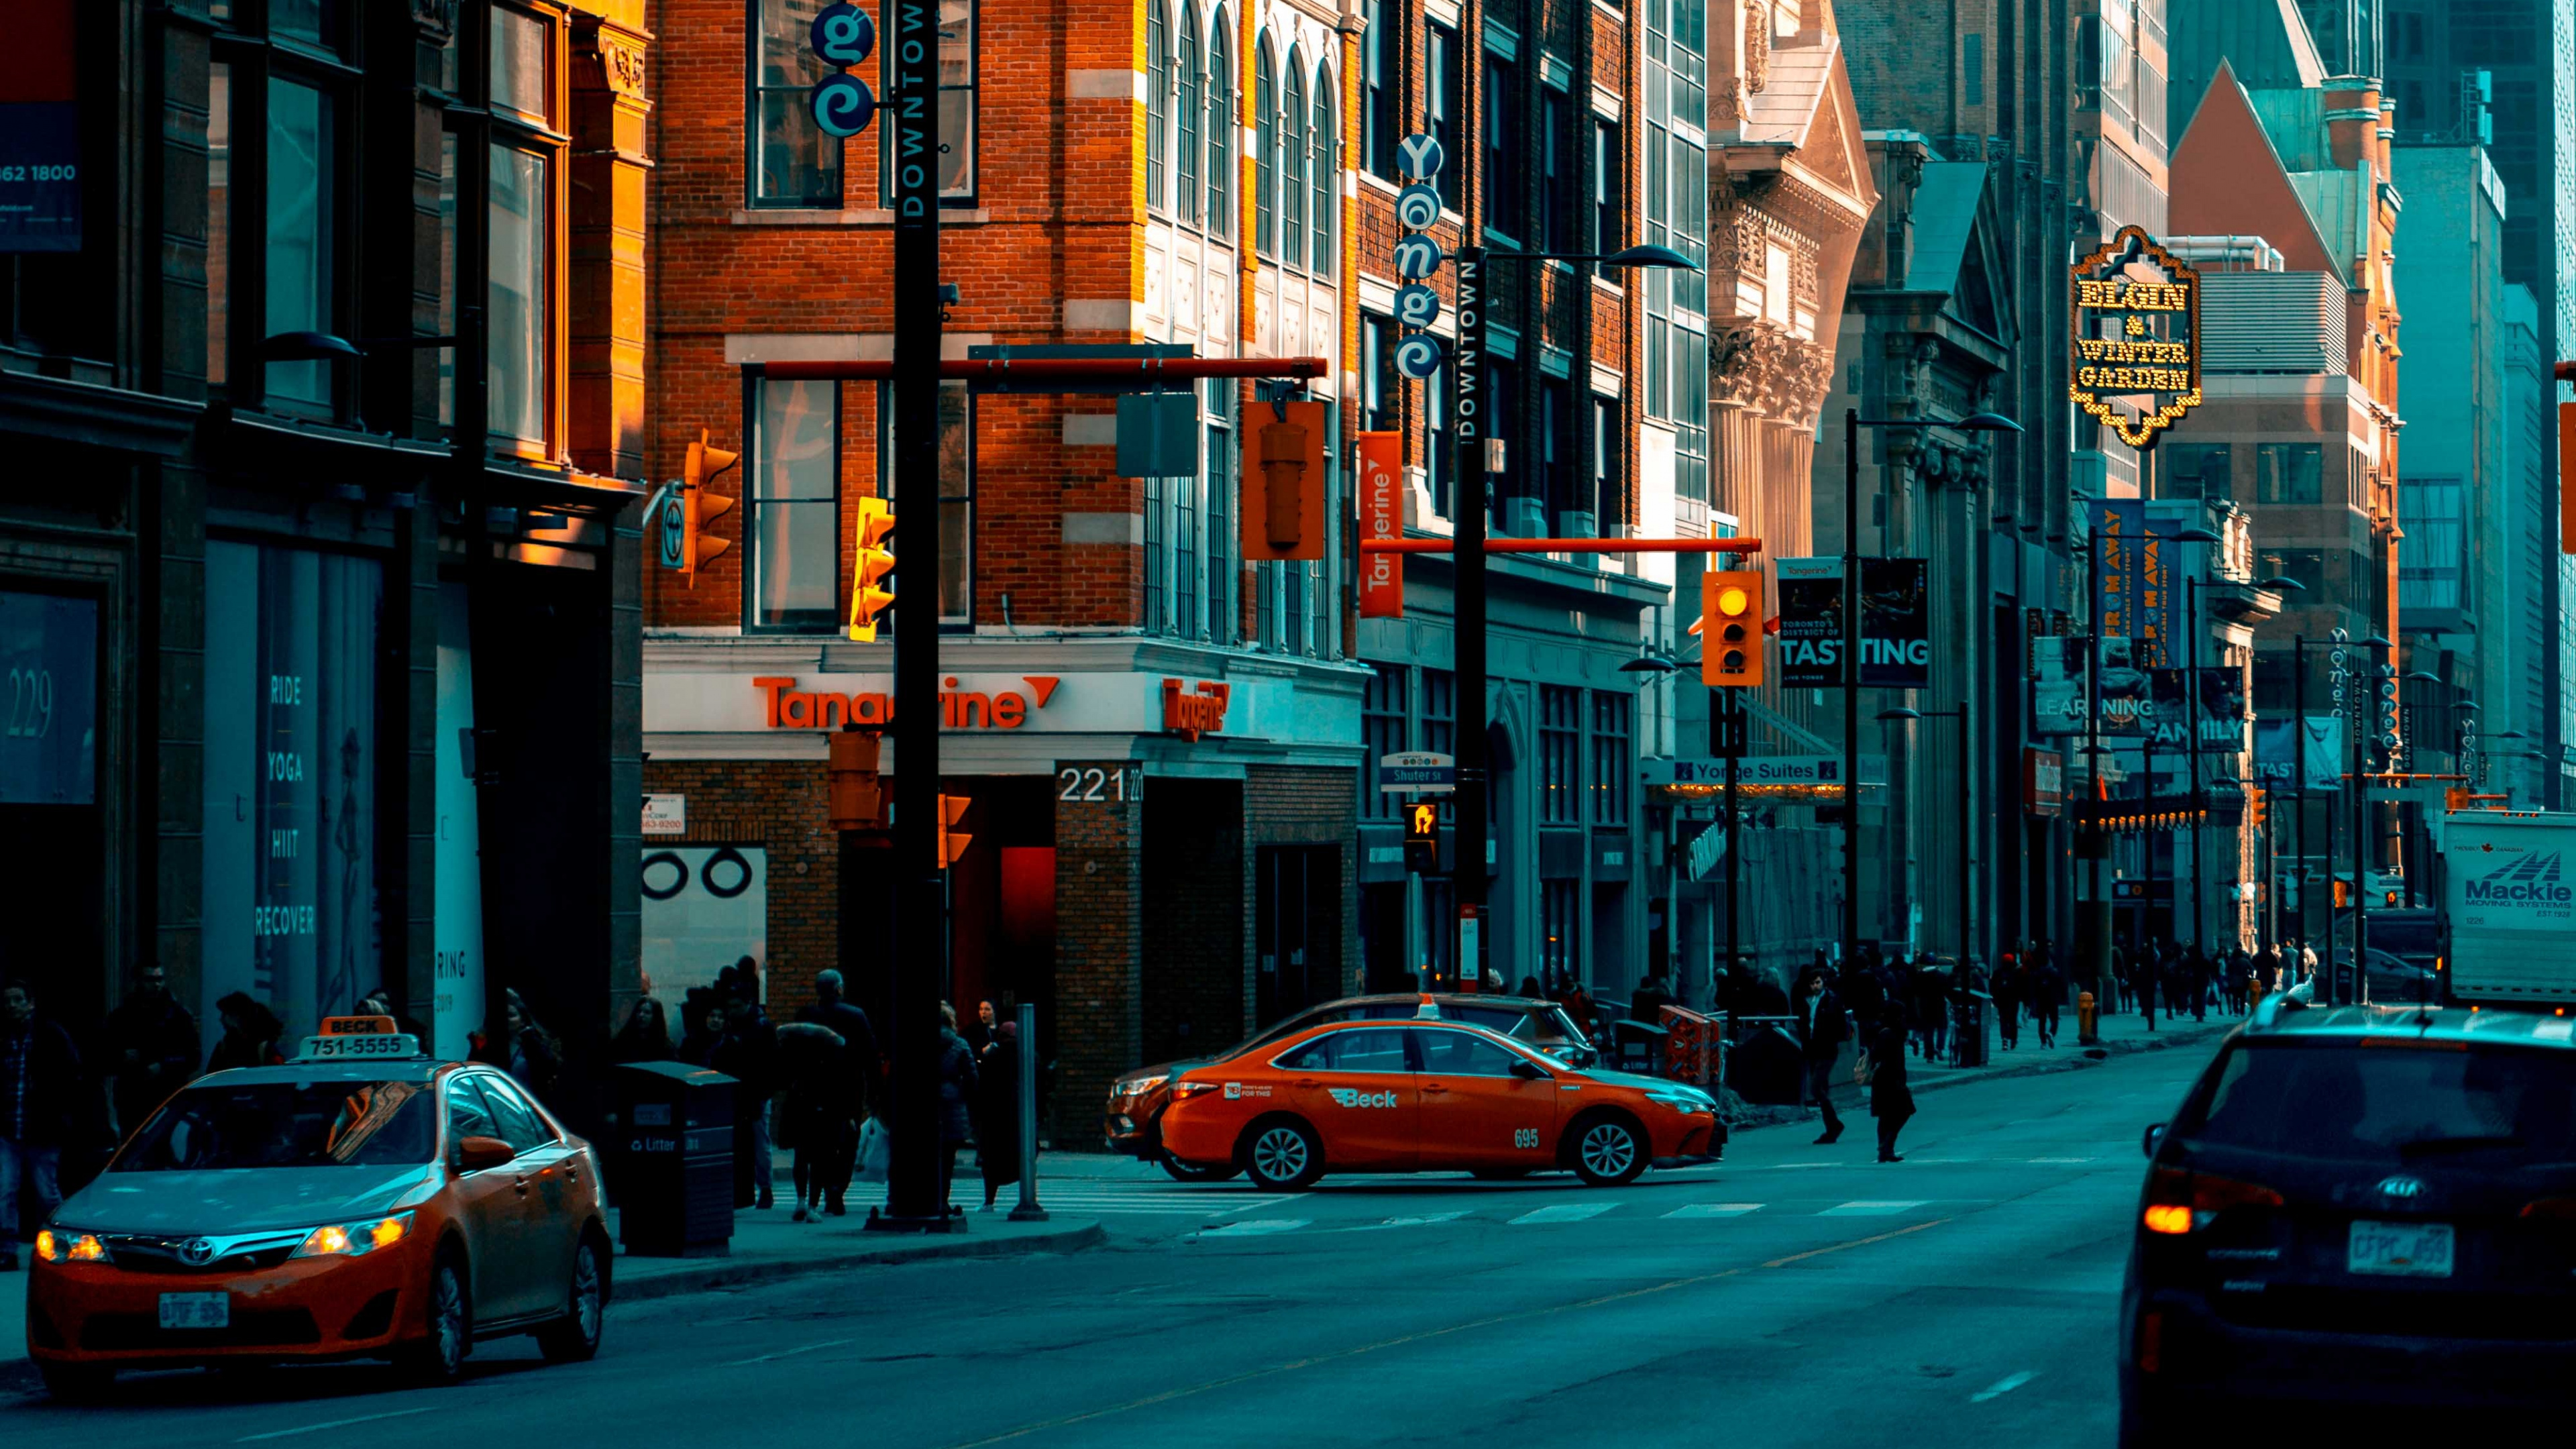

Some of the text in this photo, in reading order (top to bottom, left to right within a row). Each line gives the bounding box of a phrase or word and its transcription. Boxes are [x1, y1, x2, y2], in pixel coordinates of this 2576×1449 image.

[0, 164, 76, 181] 62 1800
[1395, 136, 1439, 379] Yonge
[2078, 280, 2189, 311] ELGIN
[2125, 314, 2145, 335] &
[1460, 262, 1476, 438] DOWNTOWN
[2078, 339, 2190, 364] WINTER
[2079, 366, 2189, 390] GARDEN
[2104, 508, 2121, 570] AWAY
[2144, 528, 2159, 586] AWAY
[1787, 566, 1829, 576] Tangerine
[1827, 628, 1839, 636] OF
[271, 675, 303, 705] RIDE
[7, 667, 52, 739] 229
[753, 677, 1026, 729] Tangine
[2354, 678, 2362, 744] DOWNTOWN
[268, 751, 303, 782] YOGA
[1394, 769, 1430, 782] Shuter
[1758, 763, 1813, 778] Suites
[1060, 768, 1124, 801] 221
[272, 828, 299, 859] HIIT
[2465, 880, 2573, 902] Mackie
[2516, 901, 2572, 909] SYSTEMS
[255, 906, 315, 936] RECOVER
[331, 1020, 380, 1033] BECK
[310, 1037, 402, 1055] 751-5555
[1342, 1087, 1397, 1108] Beck
[645, 1136, 676, 1152] Litter
[1515, 1128, 1539, 1149] 695
